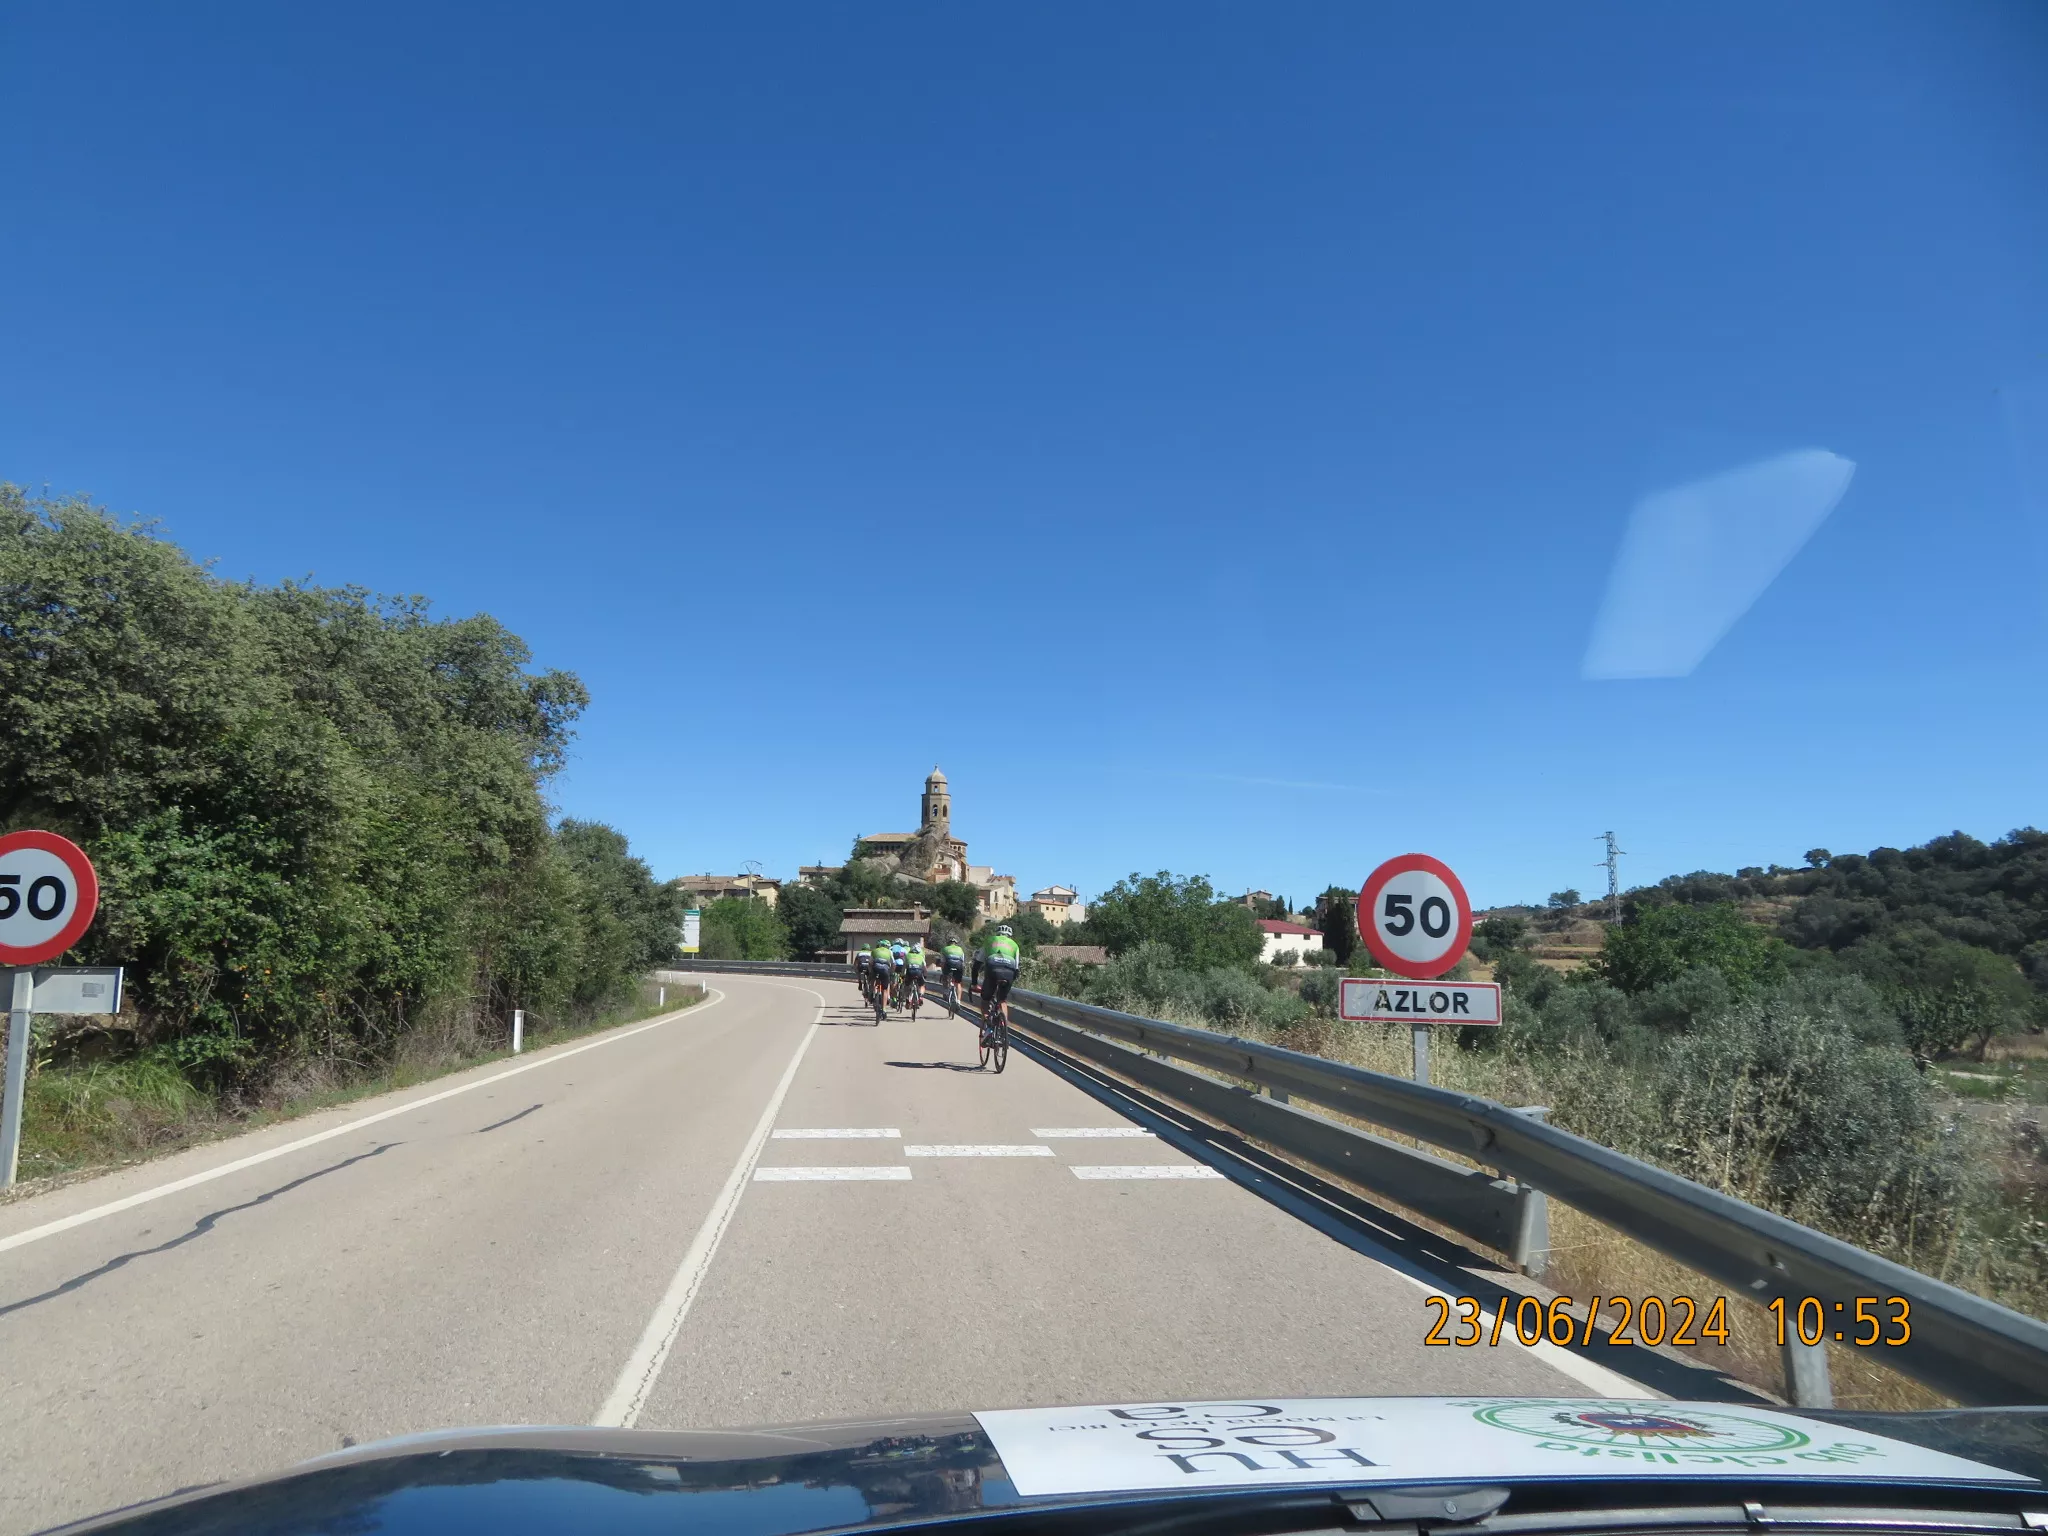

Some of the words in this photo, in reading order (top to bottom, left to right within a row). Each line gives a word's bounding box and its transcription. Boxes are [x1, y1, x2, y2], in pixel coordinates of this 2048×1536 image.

[0, 874, 67, 921] 50
[1384, 894, 1451, 939] 50
[1373, 989, 1470, 1014] AZLOR
[1534, 1441, 1788, 1468] ciclista
[1794, 1442, 1888, 1465] club
